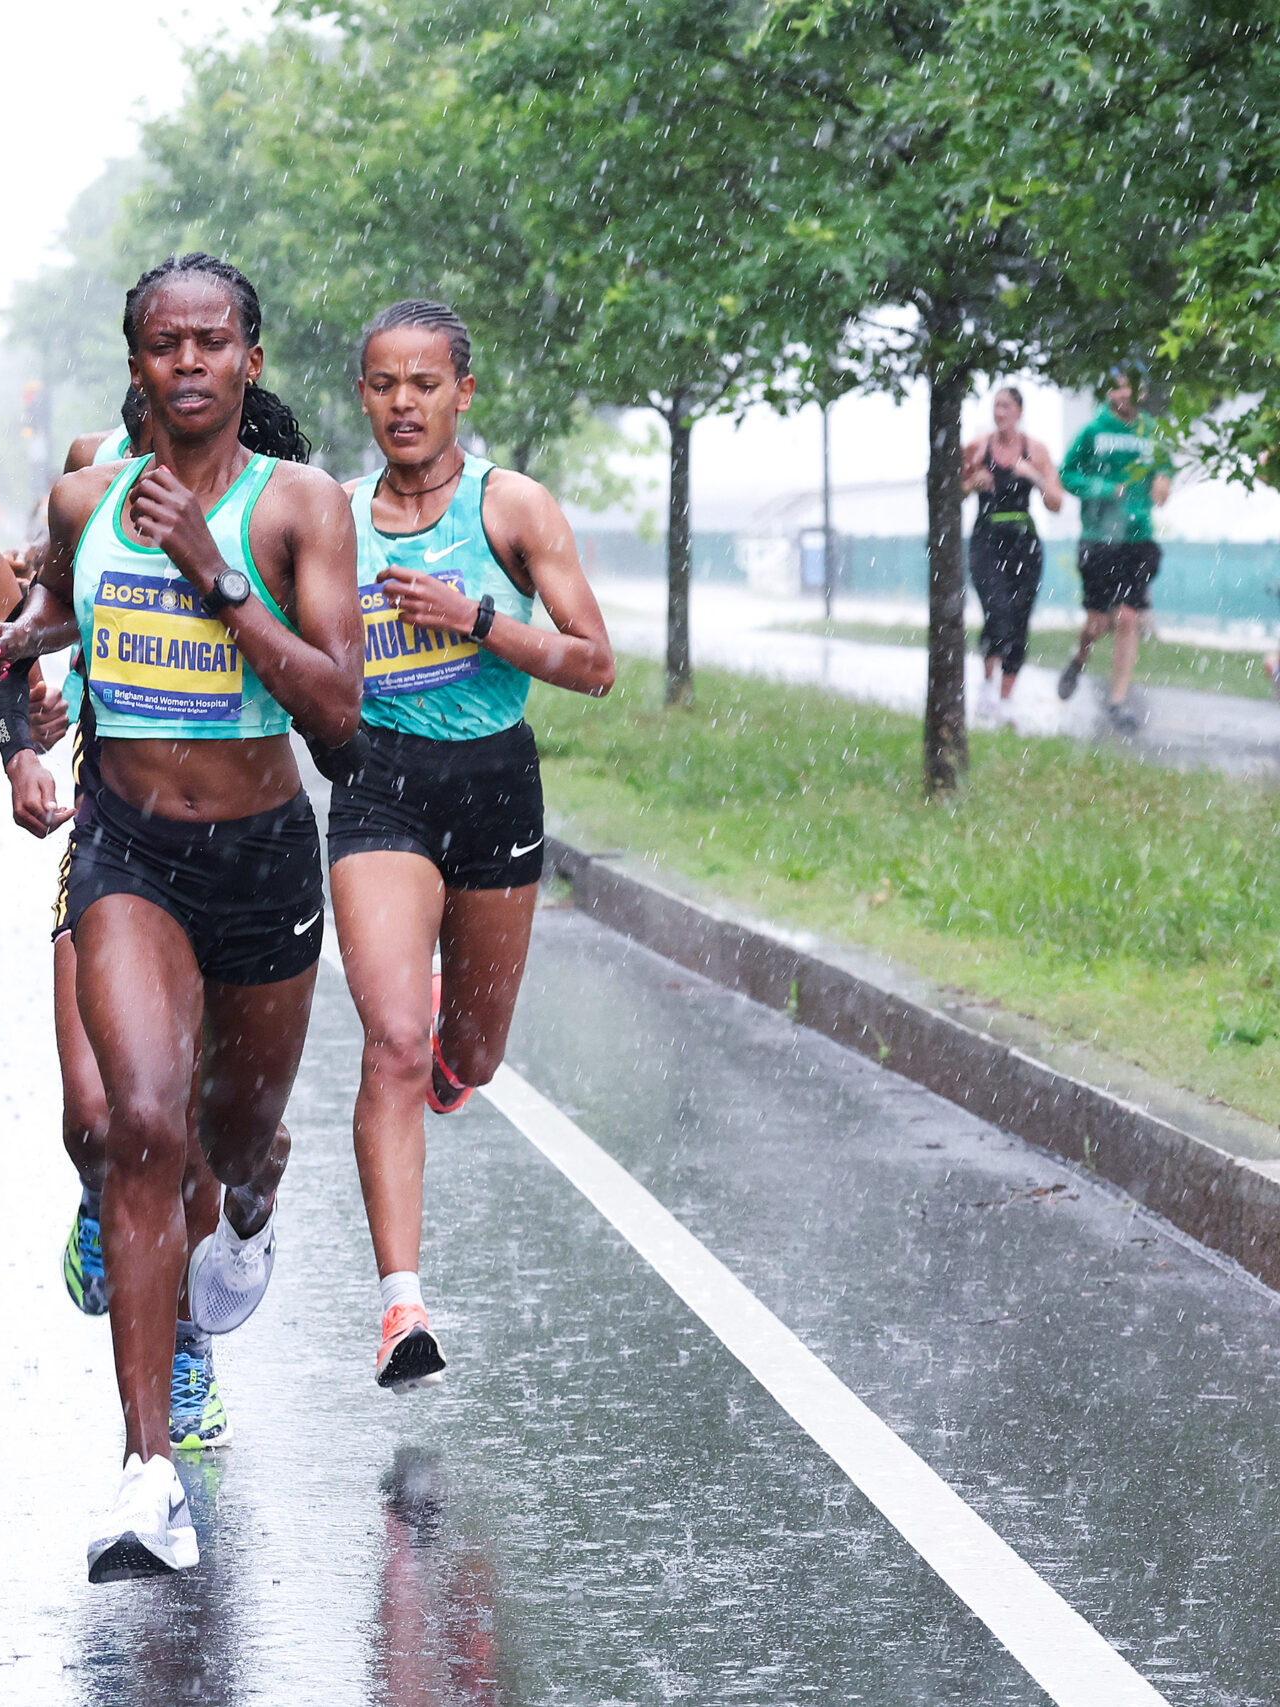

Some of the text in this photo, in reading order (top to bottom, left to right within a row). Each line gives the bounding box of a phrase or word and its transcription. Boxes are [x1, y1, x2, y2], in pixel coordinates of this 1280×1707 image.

[101, 583, 193, 611] BOSTON
[96, 628, 239, 673] S CHELANGAT
[114, 689, 229, 709] Brigham and Women's Hospital
